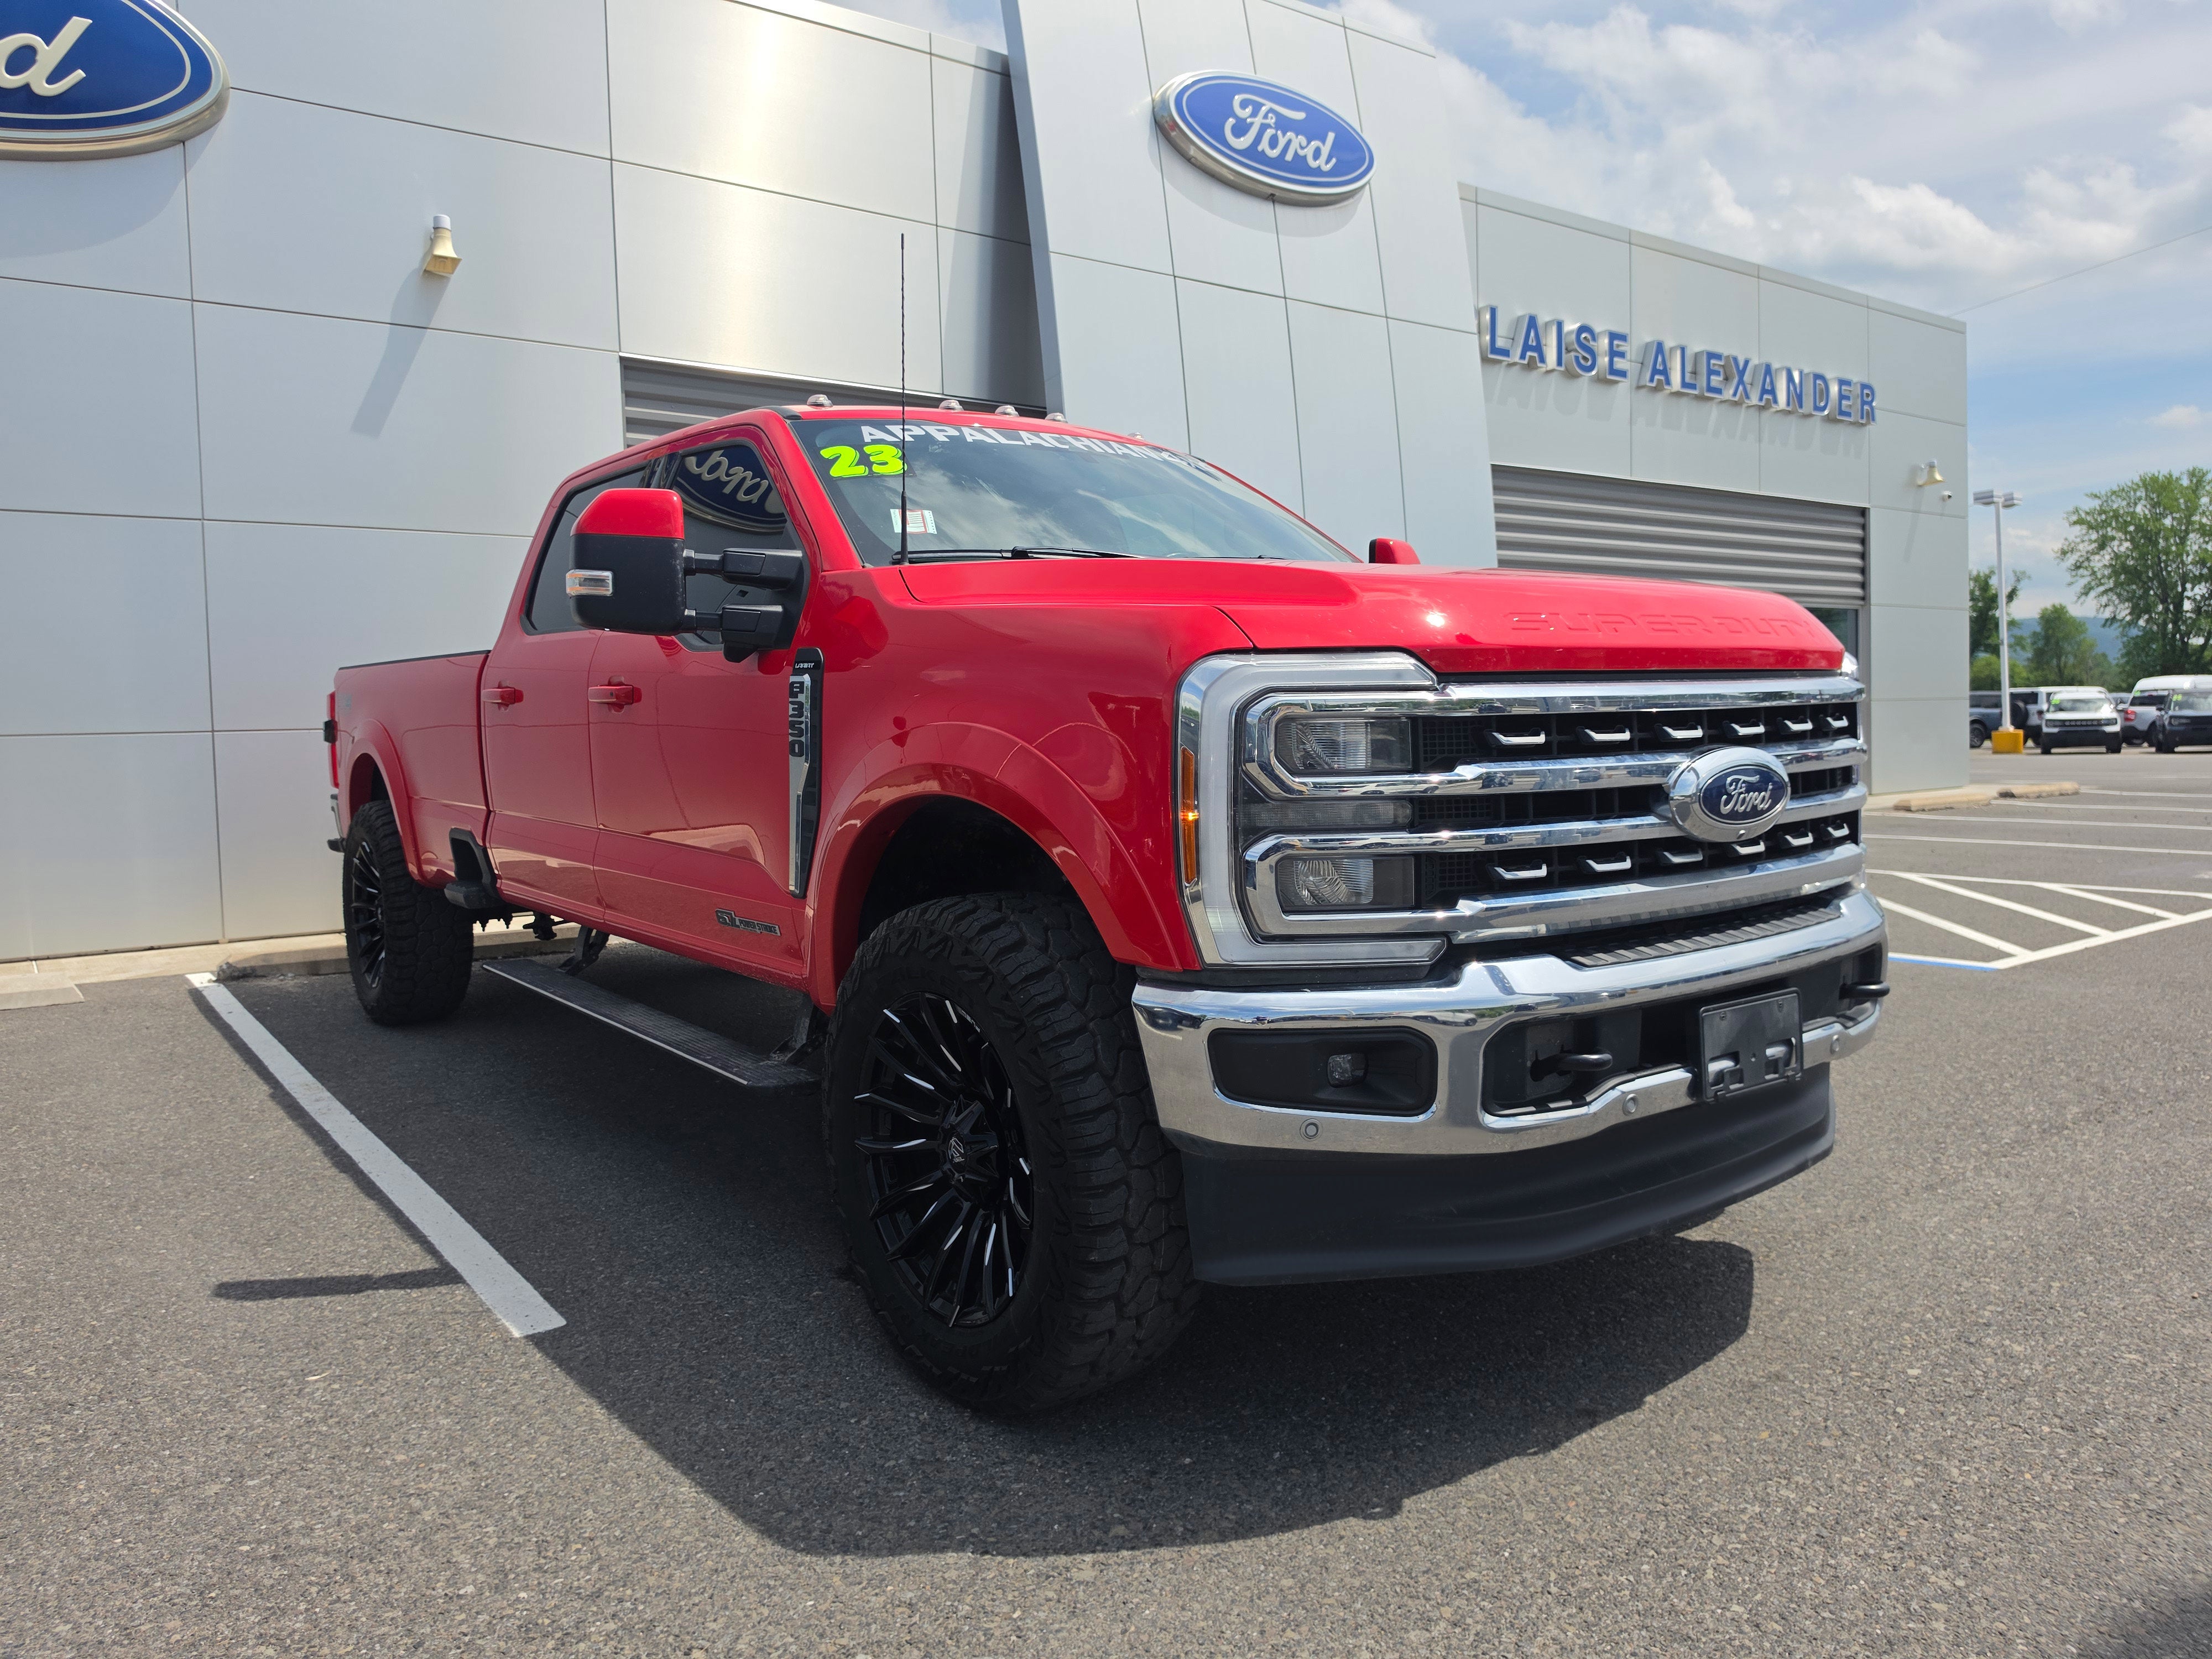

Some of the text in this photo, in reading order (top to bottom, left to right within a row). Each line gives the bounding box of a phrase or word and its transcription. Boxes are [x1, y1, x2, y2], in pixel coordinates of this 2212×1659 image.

[1224, 93, 1336, 172] Ford
[1482, 305, 1876, 425] LAISE ALEXANDER
[820, 444, 907, 478] 23
[860, 425, 1164, 461] APPALACHIAN
[1501, 612, 1816, 638] SUPER DUTY
[1720, 775, 1773, 815] Ford
